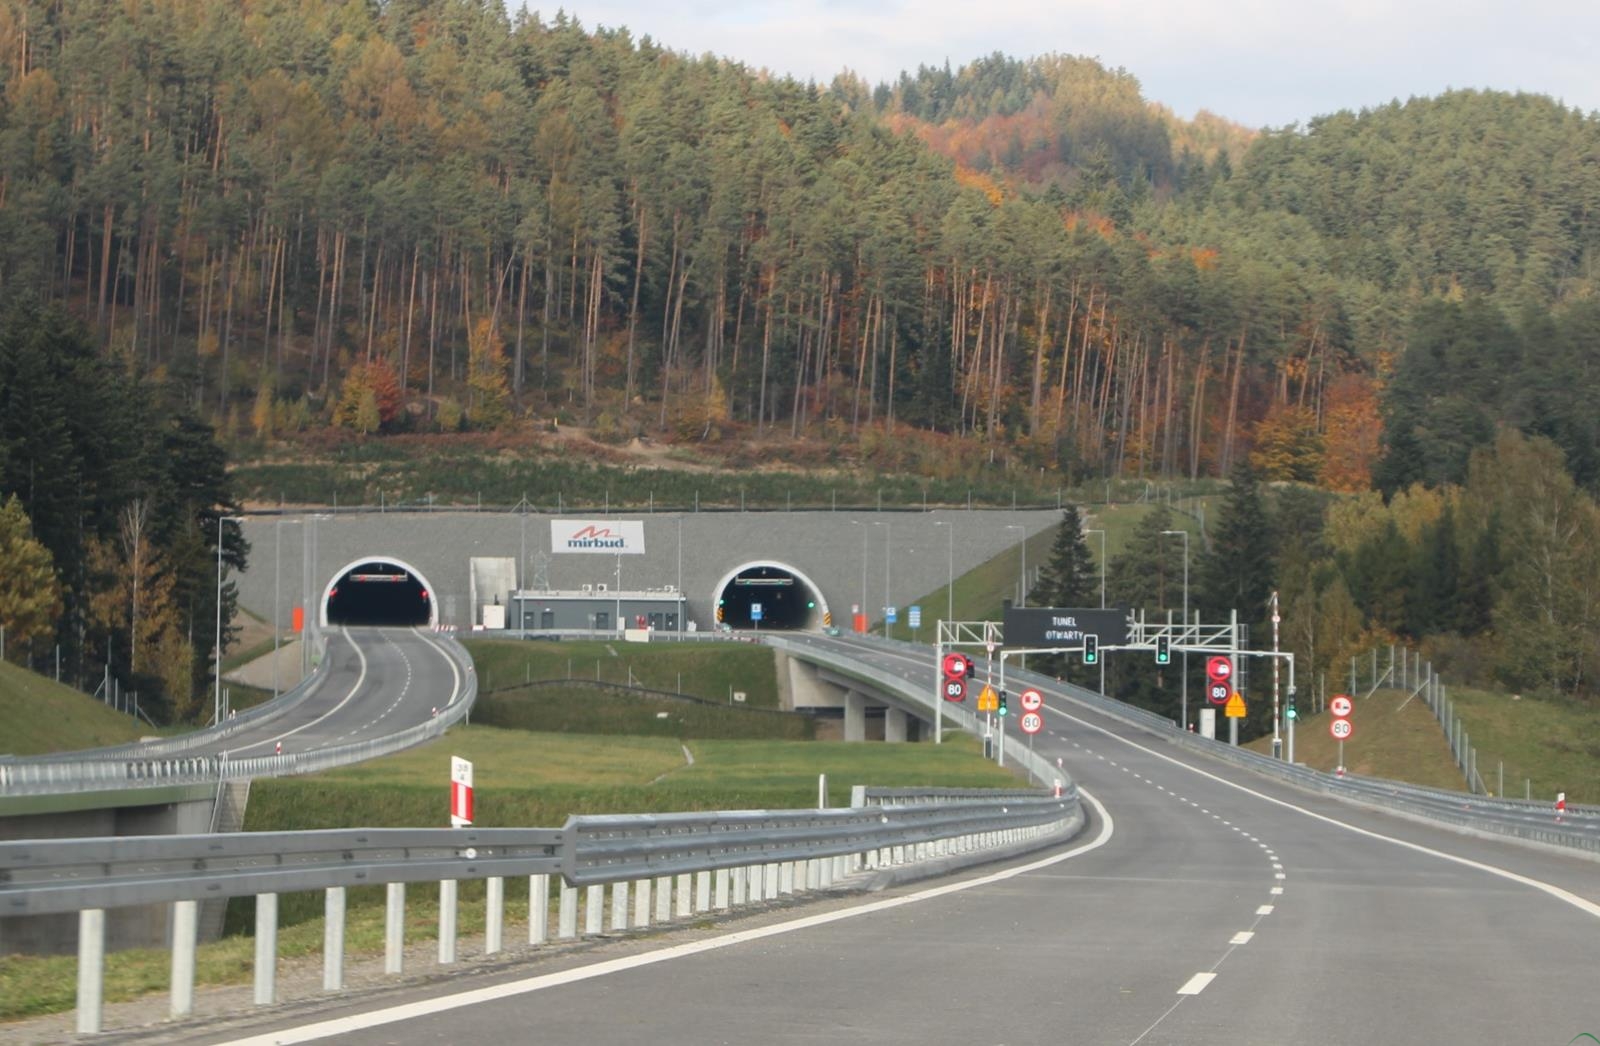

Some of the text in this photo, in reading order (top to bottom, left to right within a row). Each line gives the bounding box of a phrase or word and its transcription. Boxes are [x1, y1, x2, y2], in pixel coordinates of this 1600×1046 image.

[568, 537, 624, 548] mirbud
[1052, 616, 1077, 627] TUNEL
[1046, 630, 1084, 640] OTWARTY
[947, 684, 962, 696] 80
[1211, 687, 1227, 698] 80
[1023, 717, 1040, 729] 80
[1333, 722, 1350, 734] 80
